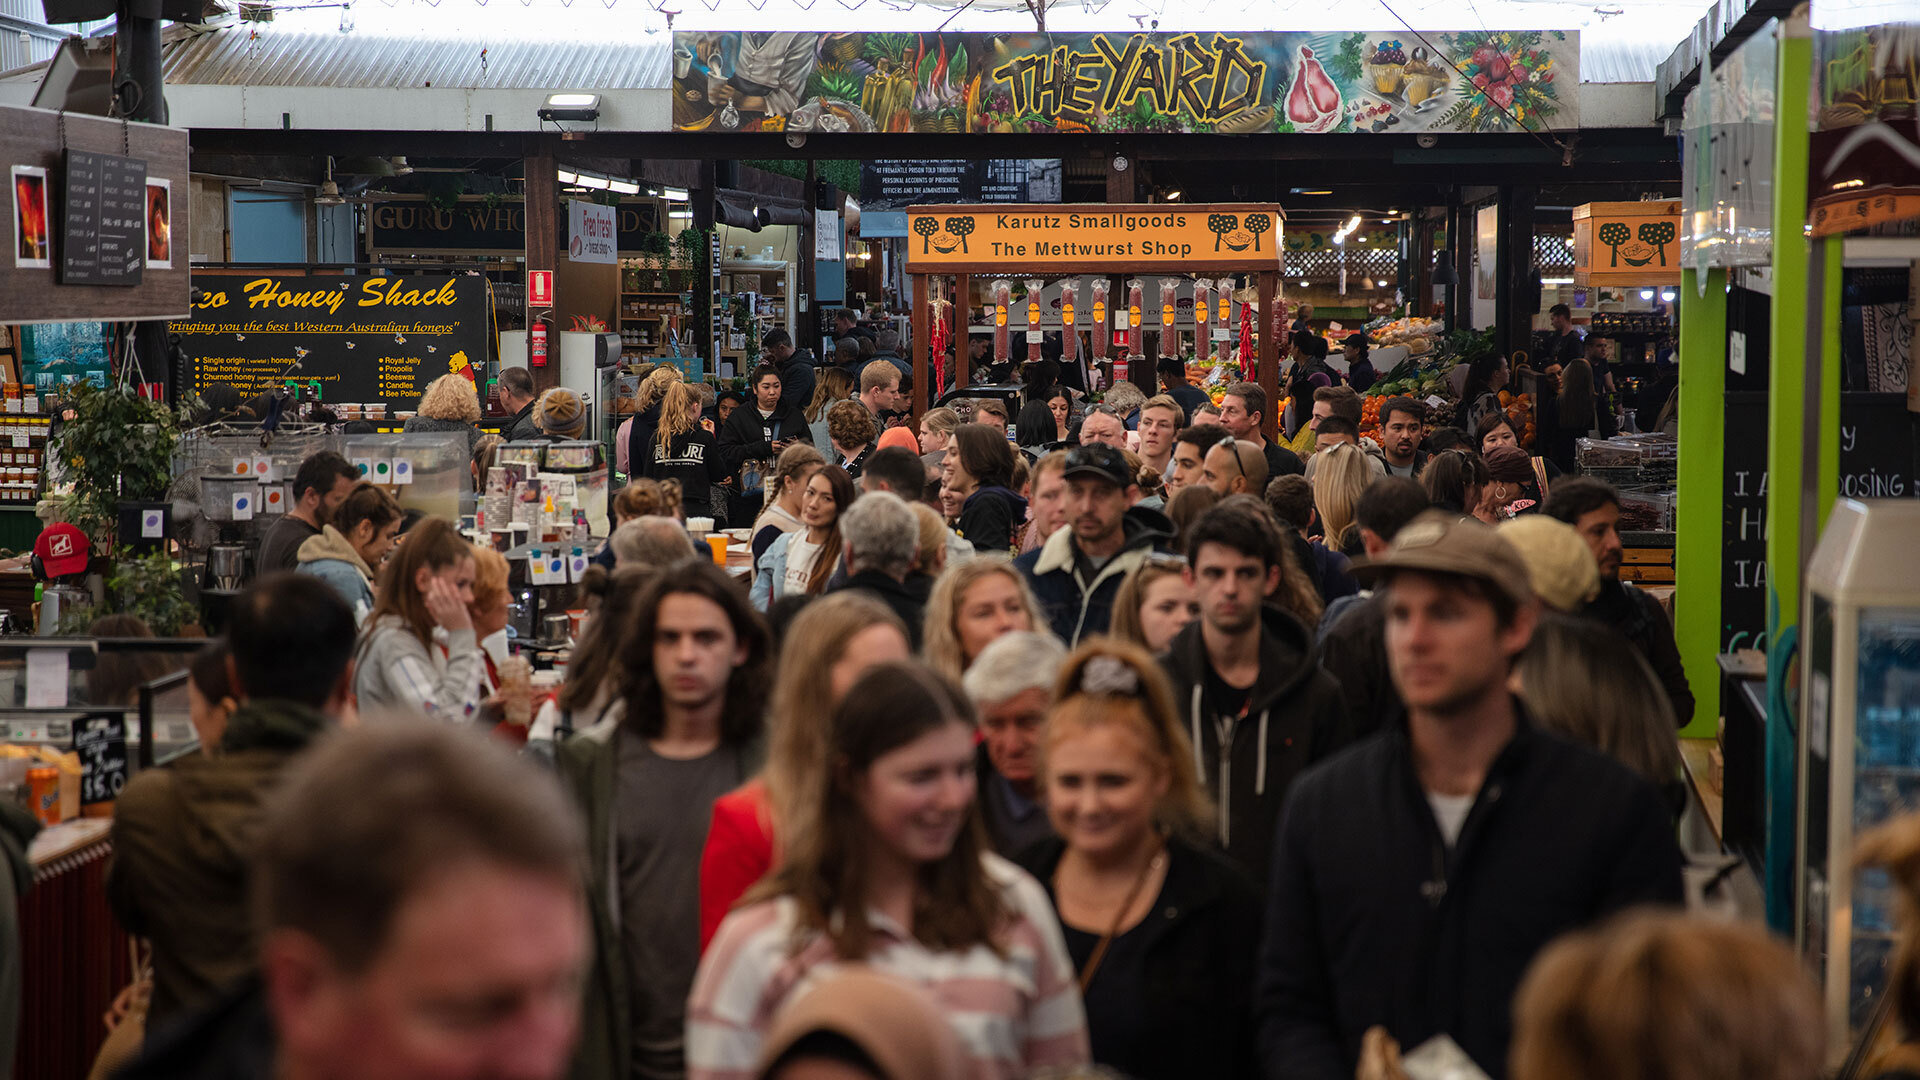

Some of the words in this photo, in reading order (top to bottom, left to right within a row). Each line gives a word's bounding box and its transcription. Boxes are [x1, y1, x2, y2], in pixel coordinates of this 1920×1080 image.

[993, 45, 1105, 117] THE
[1092, 32, 1266, 124] YARD
[374, 206, 455, 231] GURU
[997, 215, 1061, 229] Karutz
[1069, 213, 1187, 231] Smallgoods
[991, 242, 1027, 256] The
[1035, 241, 1133, 256] Mettwurst
[1142, 241, 1192, 258] Shop
[243, 278, 346, 316] Honey
[357, 278, 458, 307] Shack
[218, 323, 241, 335] you
[243, 320, 261, 332] the
[268, 320, 290, 332] best
[294, 321, 343, 332] Western
[345, 320, 410, 332] Australian
[203, 357, 225, 366] Single
[225, 357, 246, 365] origin
[270, 357, 297, 366] honeys
[385, 357, 405, 366] Royal
[405, 357, 422, 366] Jelly
[219, 365, 242, 374] honey
[385, 365, 413, 374] Propolis
[203, 373, 233, 381] Churned
[234, 373, 256, 382] honey
[385, 373, 416, 381] Beeswax
[385, 381, 414, 389] Candles
[385, 390, 400, 398] Bee
[400, 390, 422, 398] Pollen
